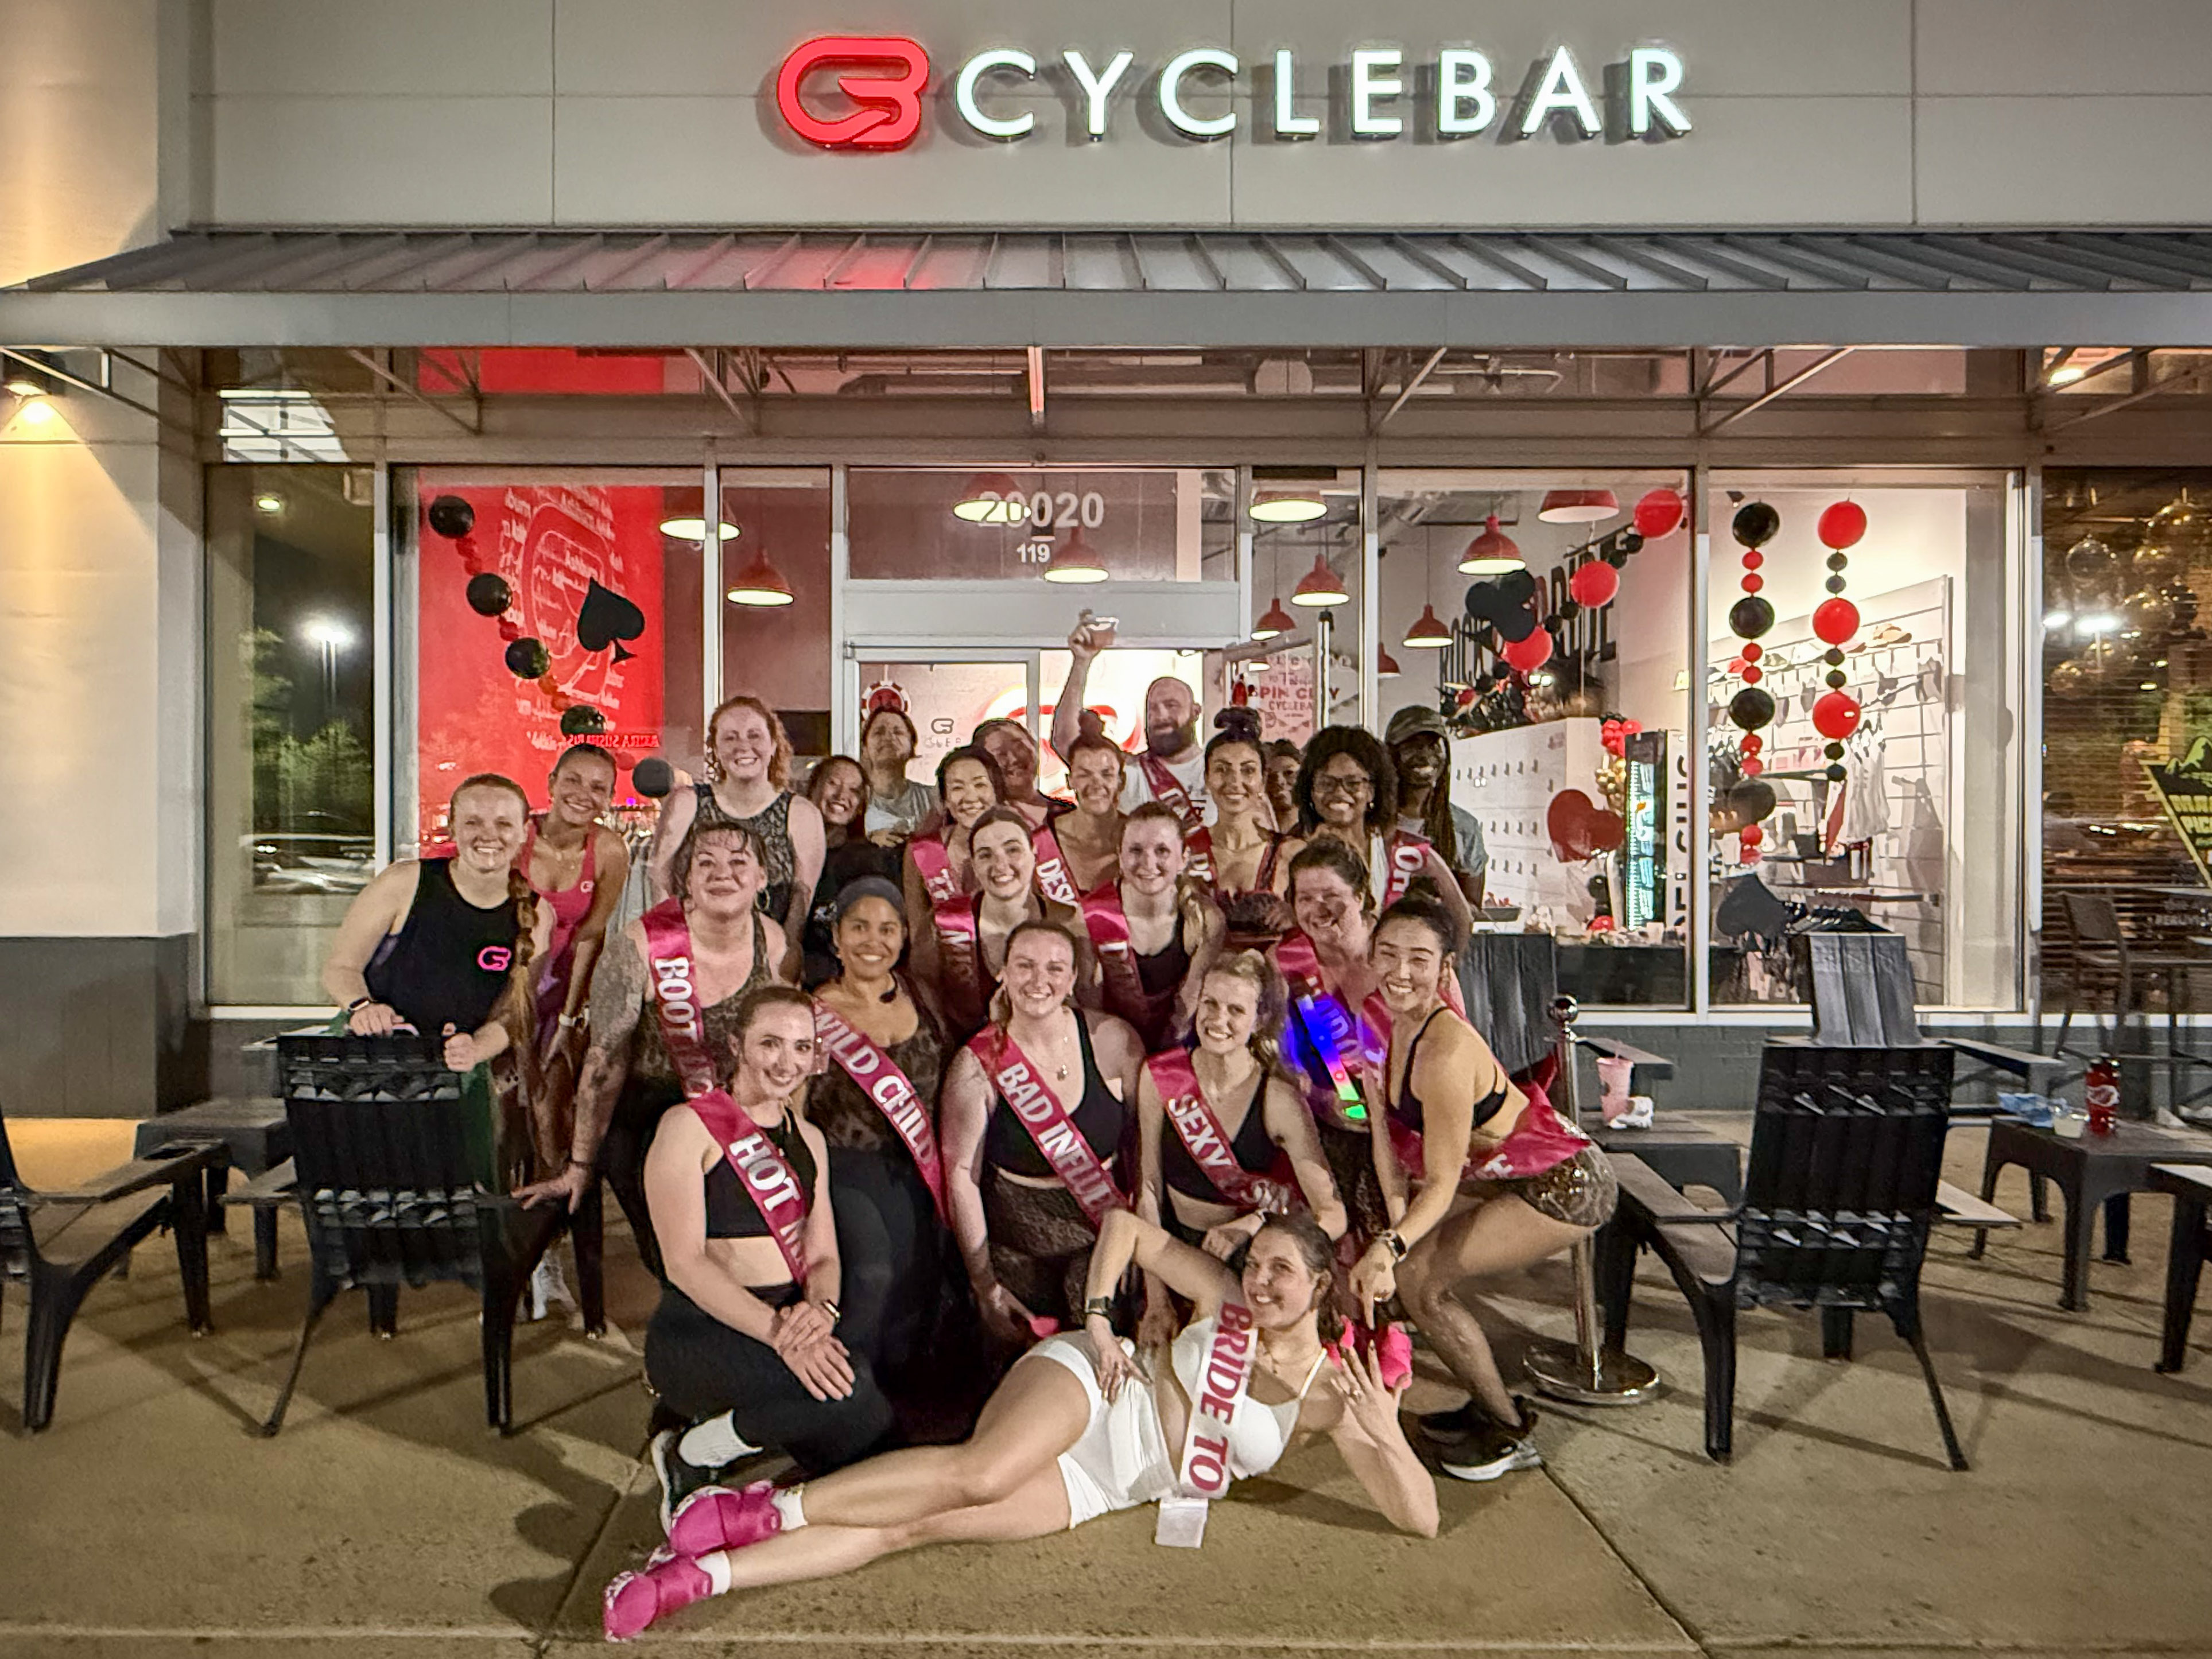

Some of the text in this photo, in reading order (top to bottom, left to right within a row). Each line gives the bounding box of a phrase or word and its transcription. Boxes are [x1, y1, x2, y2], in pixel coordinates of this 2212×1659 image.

[955, 45, 1692, 138] CYCLEBAR
[977, 491, 1104, 529] 20020
[1016, 543, 1050, 563] 119
[872, 1075, 933, 1164] CHILD
[996, 1062, 1054, 1122] BAD
[1168, 1093, 1233, 1166] SEXY
[729, 1132, 801, 1212] HOT
[1189, 1302, 1254, 1491] BRIDE TO
